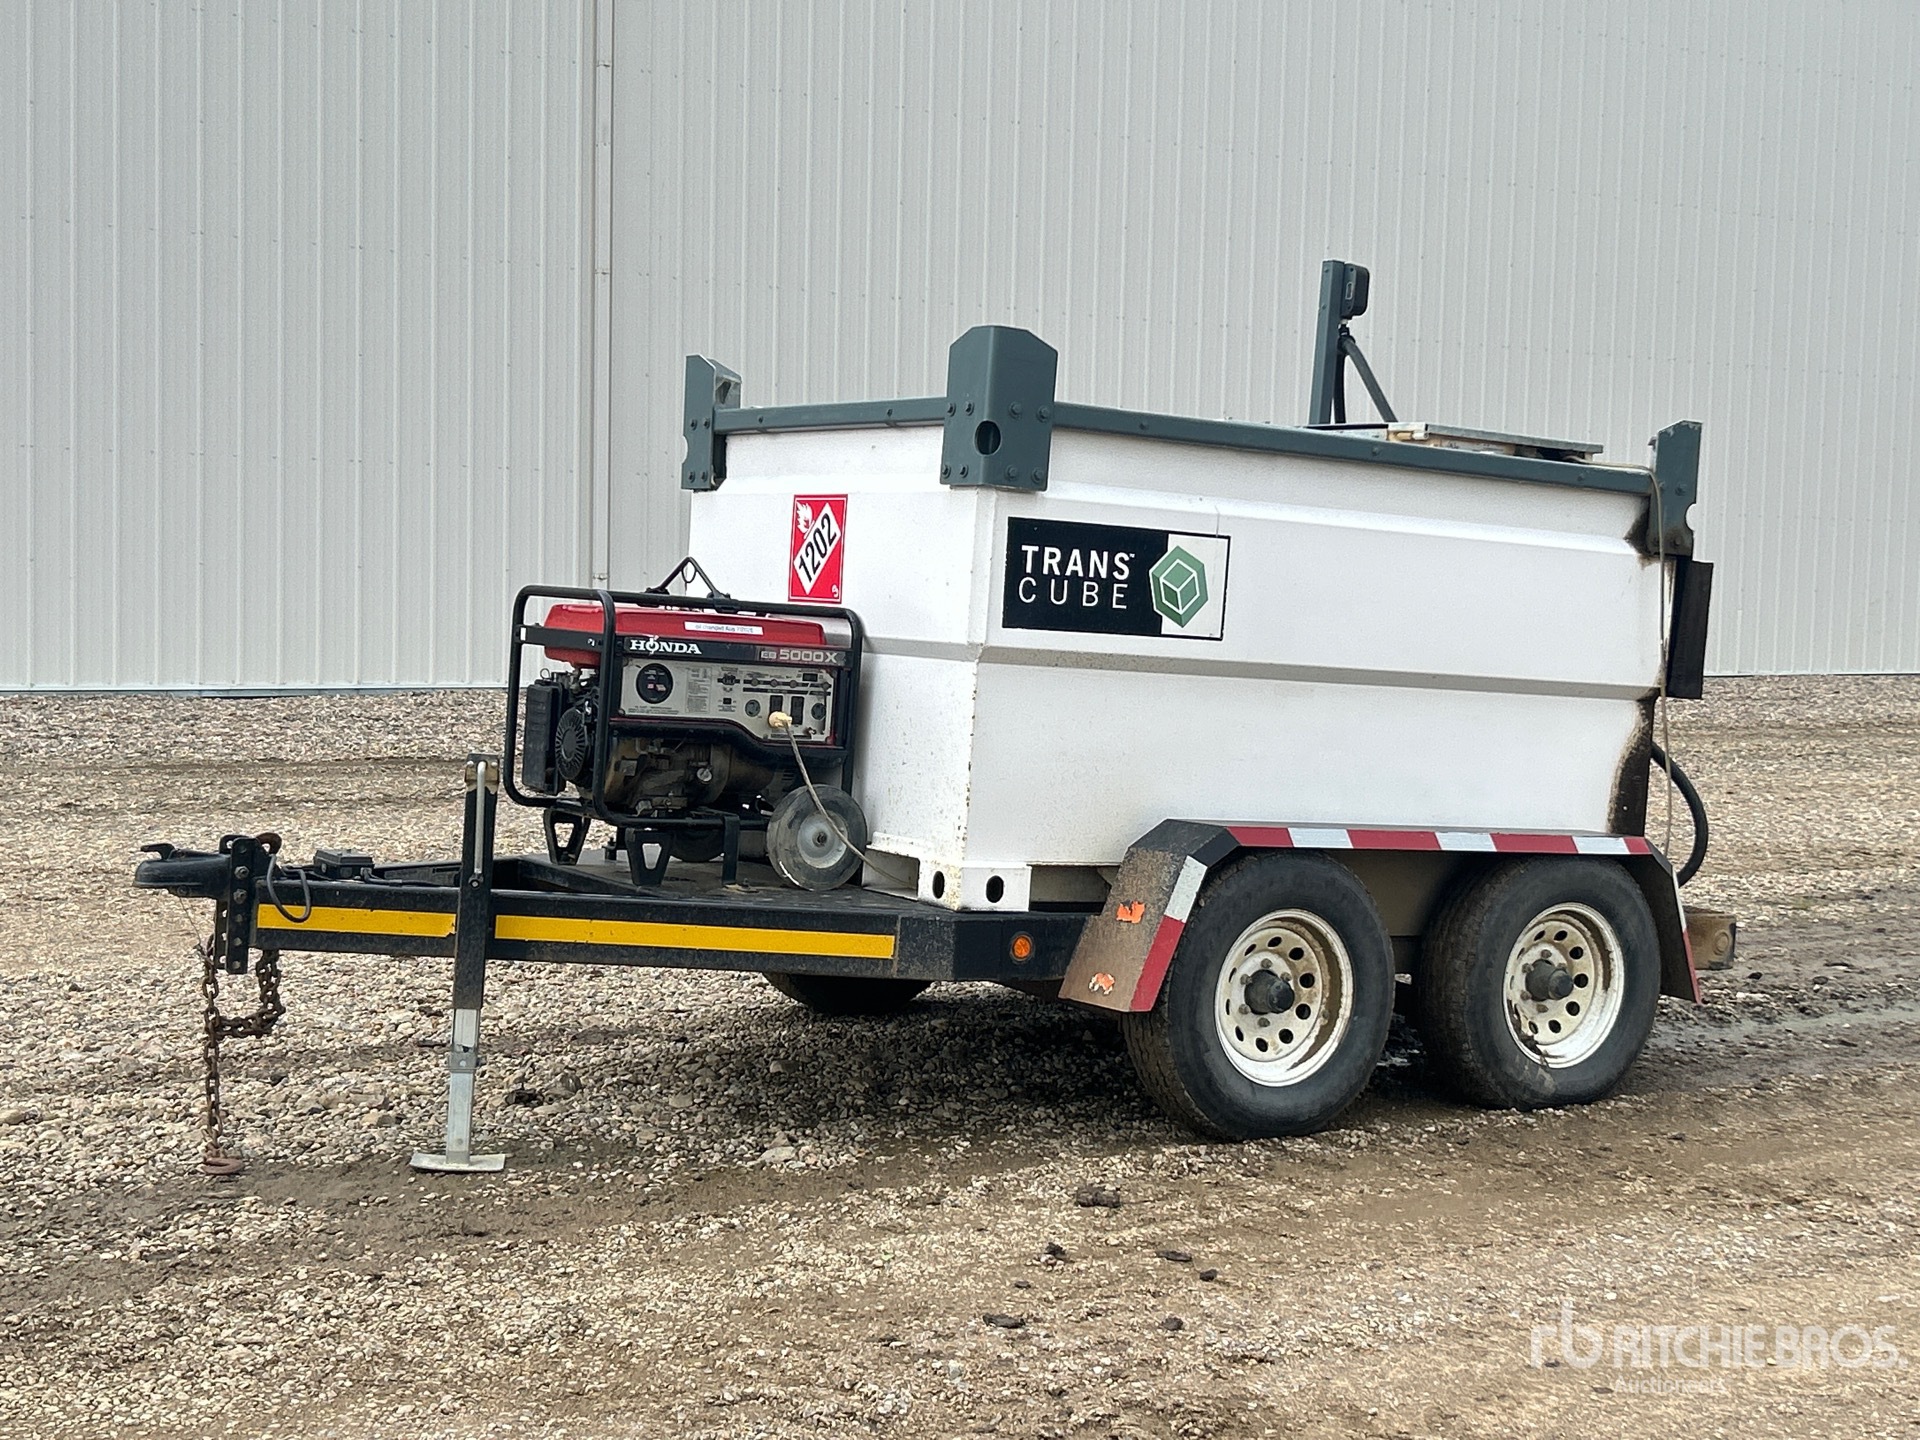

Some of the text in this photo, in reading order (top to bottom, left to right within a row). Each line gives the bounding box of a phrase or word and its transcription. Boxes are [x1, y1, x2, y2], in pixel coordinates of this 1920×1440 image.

[798, 512, 838, 584] 1202
[1021, 545, 1131, 581] TRANS
[1018, 576, 1129, 609] CUBE
[629, 638, 703, 655] HONDA
